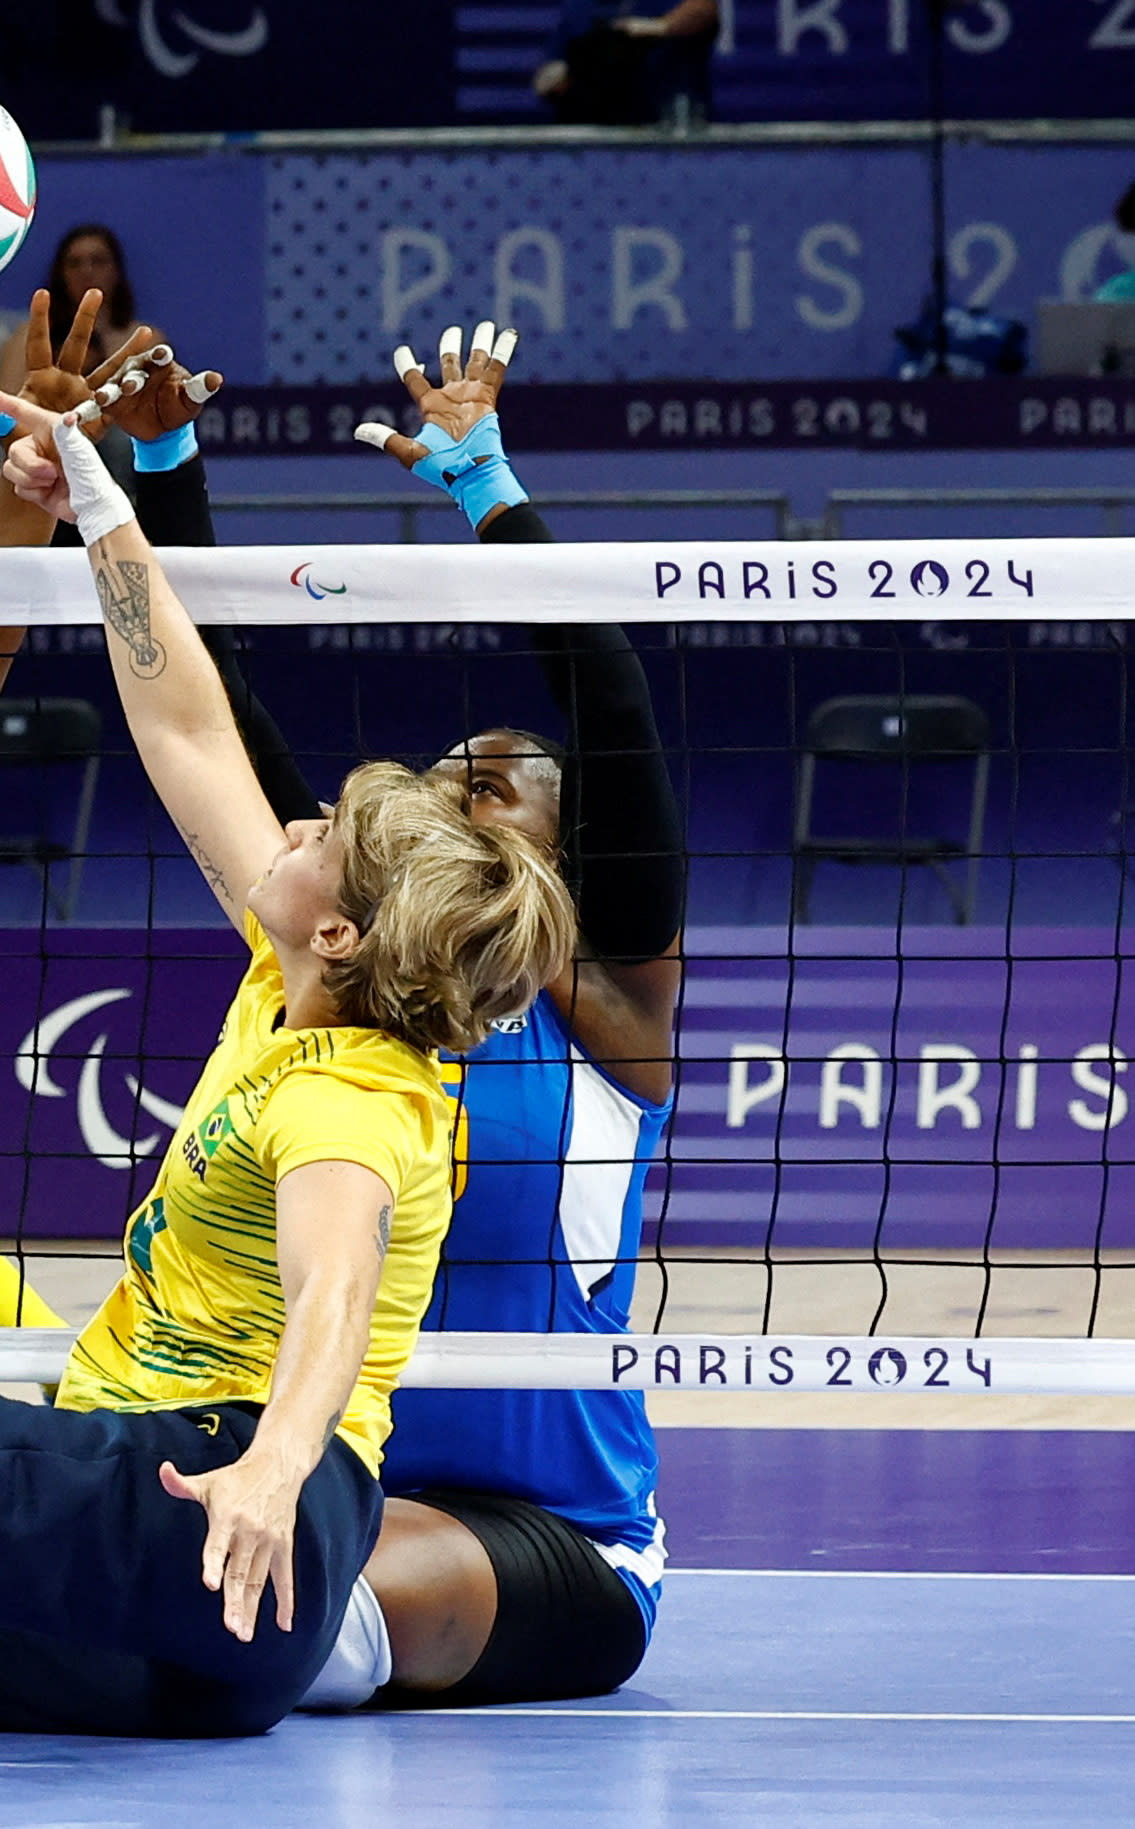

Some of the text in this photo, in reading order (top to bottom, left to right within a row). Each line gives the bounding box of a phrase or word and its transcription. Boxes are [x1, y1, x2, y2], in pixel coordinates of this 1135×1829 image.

[792, 398, 928, 438] 2024
[869, 560, 1033, 597] 2024
[183, 1131, 206, 1184] BRA
[827, 1347, 990, 1387] 2024
